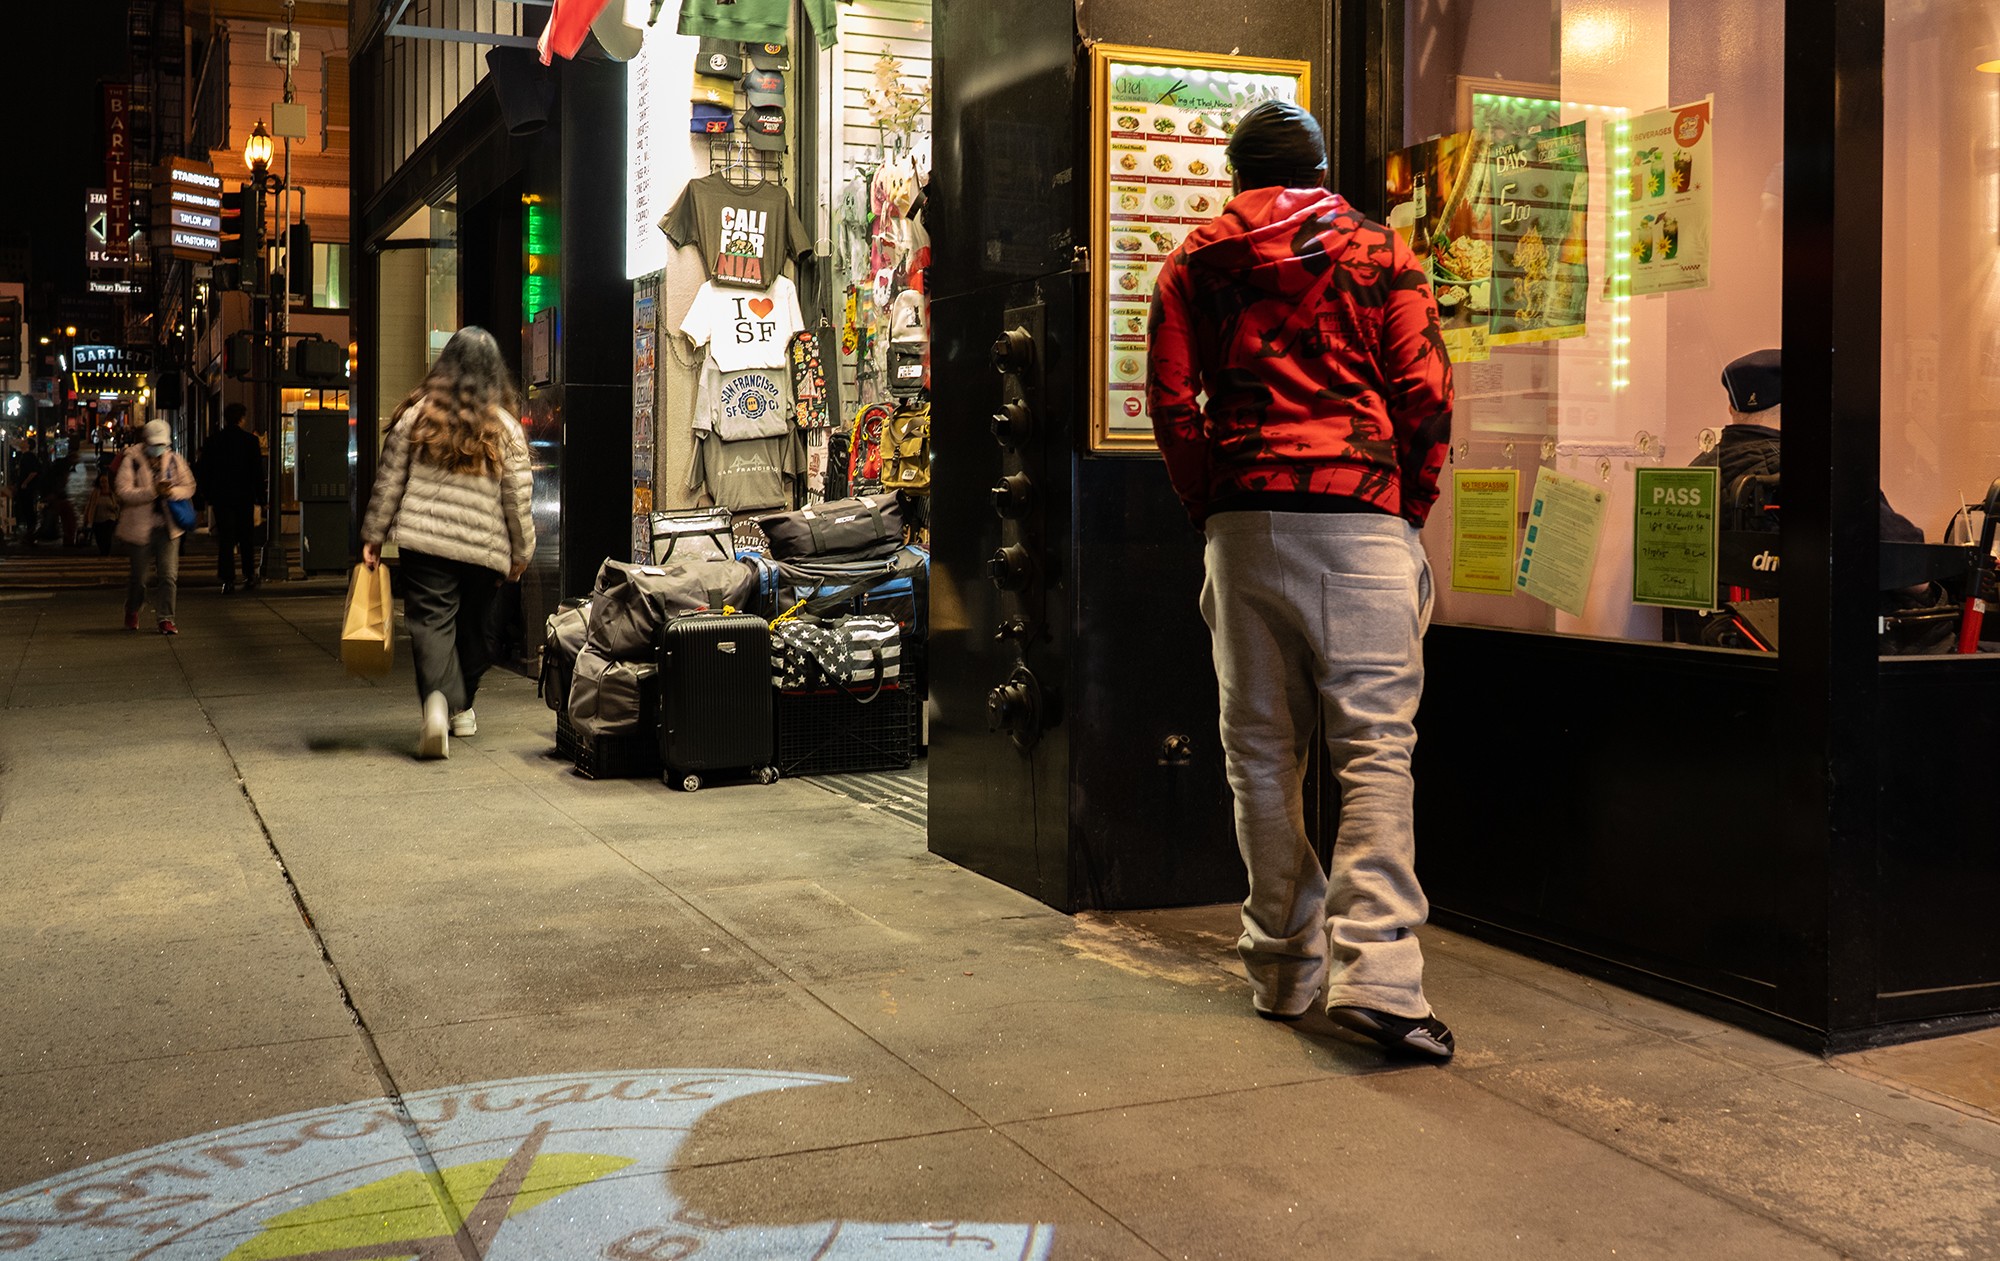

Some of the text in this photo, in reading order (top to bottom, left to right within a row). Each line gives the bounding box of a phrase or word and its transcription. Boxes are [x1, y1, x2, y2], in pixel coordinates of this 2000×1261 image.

[1115, 77, 1144, 95] Chef
[1634, 127, 1672, 141] BEVERAGES
[1495, 144, 1515, 156] HAPPY
[111, 99, 125, 236] BARTLETT
[1497, 150, 1527, 174] DAYS
[172, 169, 220, 188] STARBUCKS
[180, 213, 201, 226] TAYLOR
[721, 206, 767, 234] CALI
[175, 234, 217, 249] AL PASTOR PAPI
[720, 230, 765, 258] FOR
[717, 252, 762, 279] NIA
[732, 297, 747, 320] I
[736, 321, 776, 344] SF
[77, 349, 152, 364] BARTLETT
[97, 363, 129, 373] HALL
[721, 384, 736, 404] SAN
[726, 405, 738, 417] SF
[1653, 487, 1701, 506] PASS
